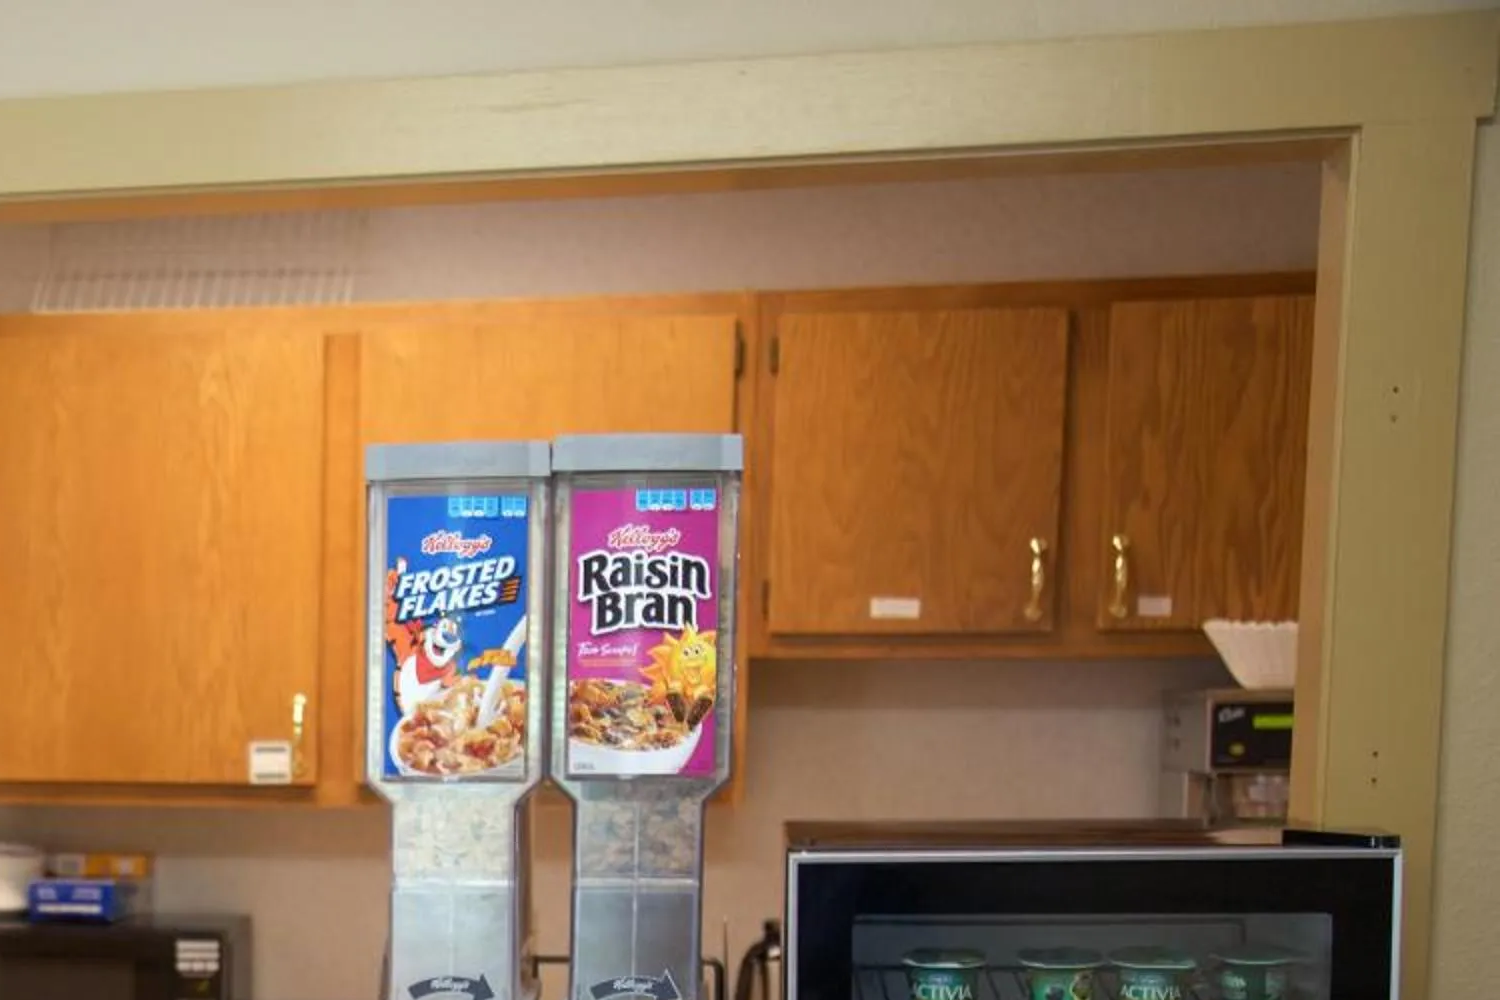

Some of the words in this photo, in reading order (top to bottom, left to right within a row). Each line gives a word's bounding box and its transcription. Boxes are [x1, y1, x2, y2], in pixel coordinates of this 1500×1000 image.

[421, 530, 493, 557] Kellogg's
[608, 523, 681, 552] Kellogg's
[397, 556, 515, 602] FROSTED
[581, 551, 710, 600] Raisin
[399, 580, 499, 621] FLAKES
[594, 590, 696, 633] Bran
